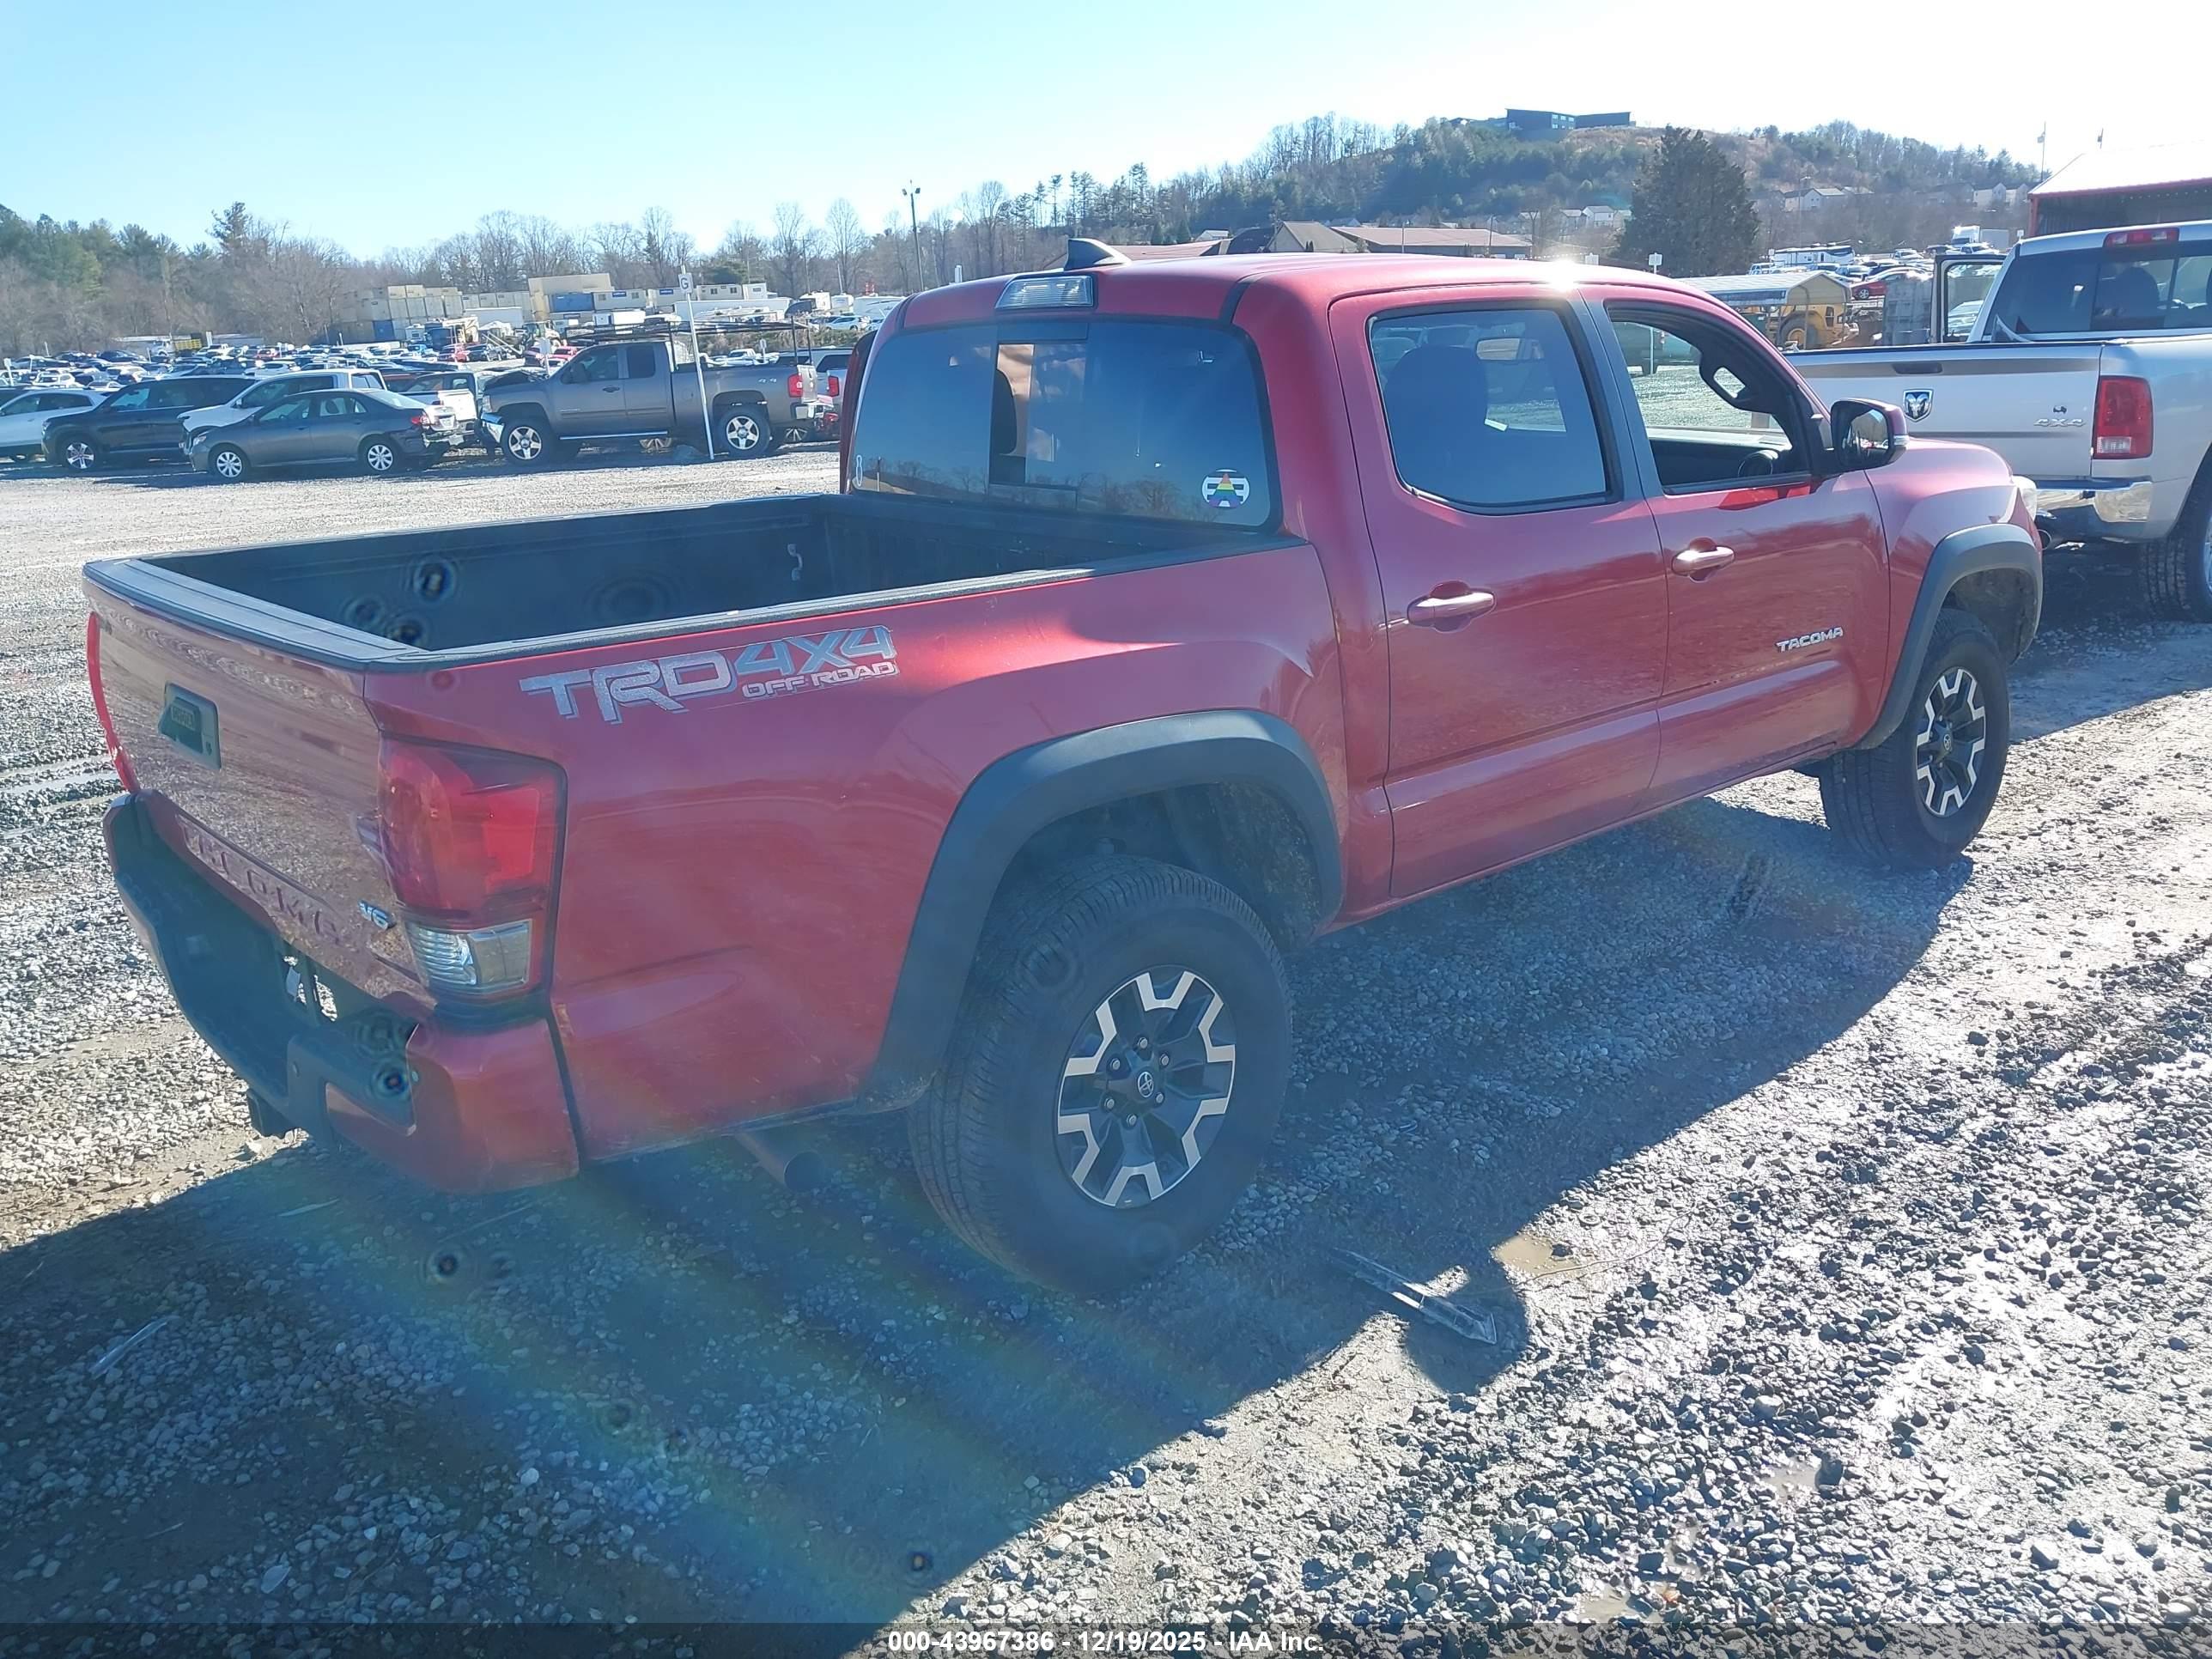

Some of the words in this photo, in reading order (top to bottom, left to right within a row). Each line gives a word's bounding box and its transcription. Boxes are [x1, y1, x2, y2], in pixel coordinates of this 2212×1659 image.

[681, 277, 689, 289] G
[1776, 626, 1844, 653] TACOMA
[520, 650, 737, 724] TRD
[742, 674, 805, 698] OFF
[811, 661, 898, 687] ROAD
